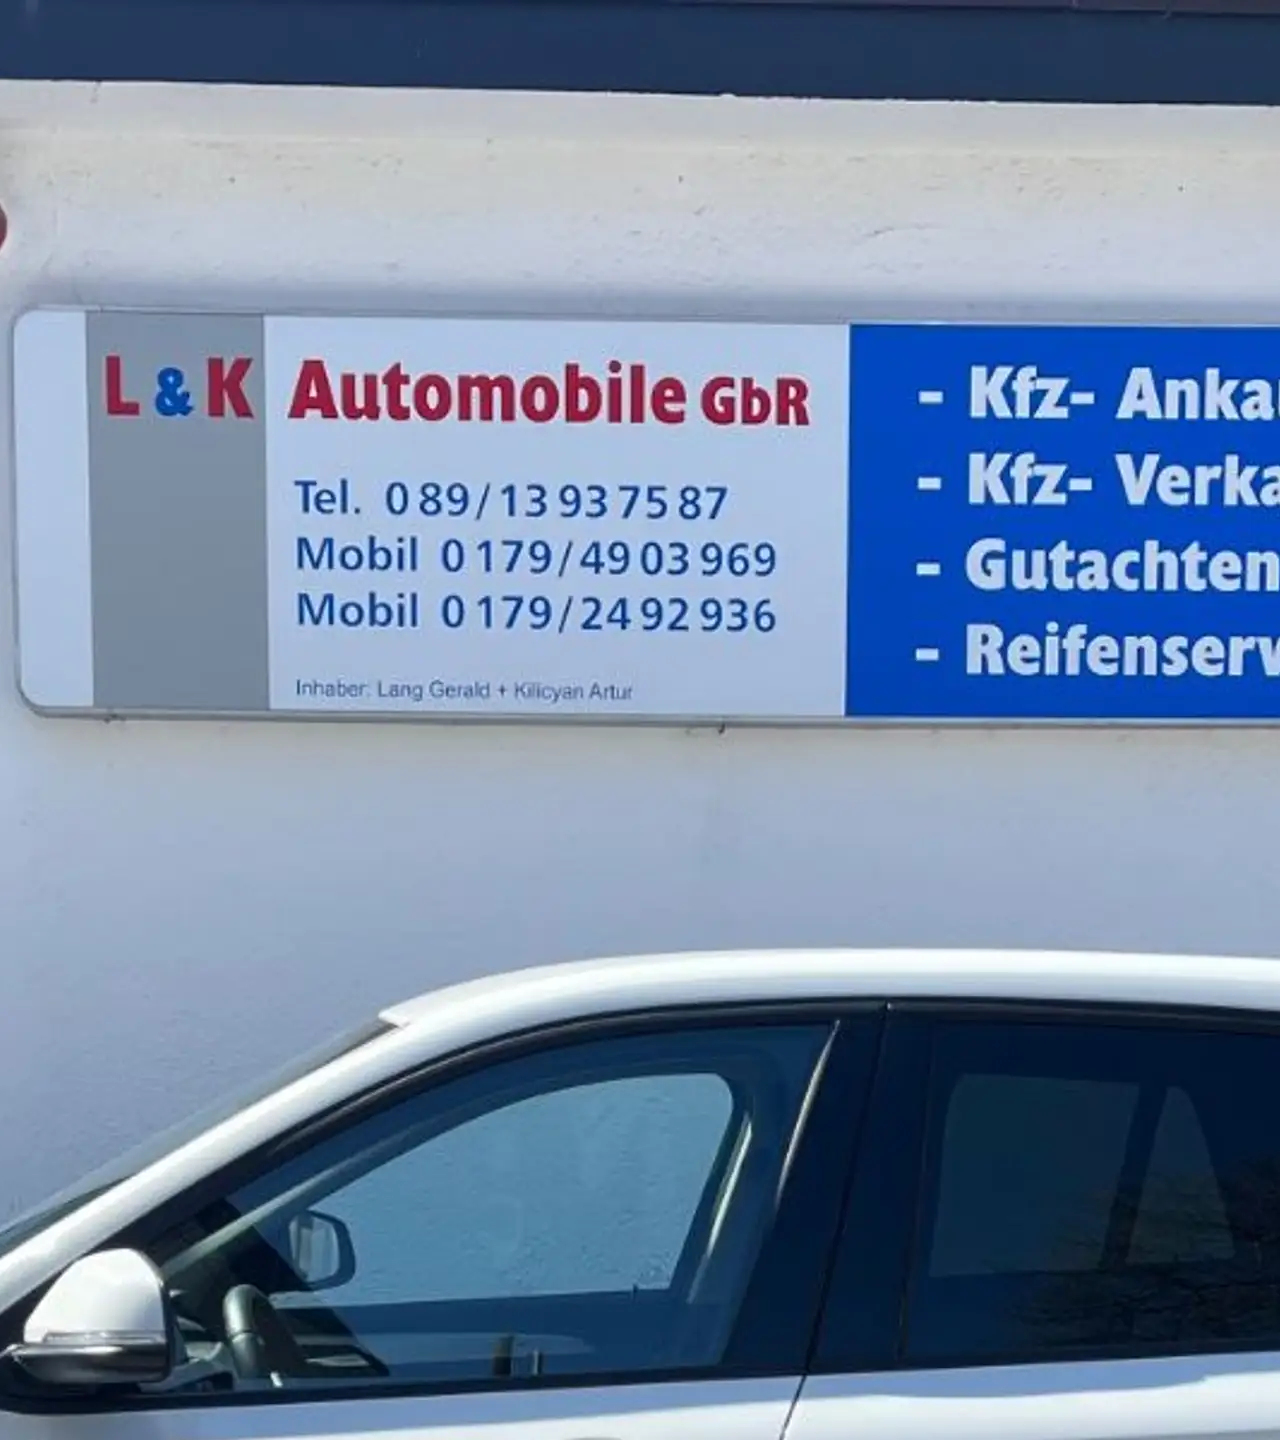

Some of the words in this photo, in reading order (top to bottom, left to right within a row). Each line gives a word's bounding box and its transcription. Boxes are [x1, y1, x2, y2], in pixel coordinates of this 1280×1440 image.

[106, 355, 141, 417] L
[152, 364, 196, 420] &
[206, 357, 251, 419] K
[288, 360, 687, 425] Automobile
[701, 375, 810, 426] GbR
[970, 365, 1095, 419] Kfz-
[293, 478, 361, 515] Tel.
[968, 452, 1093, 505] Kfz-
[296, 535, 418, 573] Mobil
[965, 537, 1280, 592] Gutachten
[297, 591, 418, 629] Mobil
[377, 680, 423, 702] Lang
[429, 680, 491, 700] Gerald
[588, 682, 634, 701] Artur
